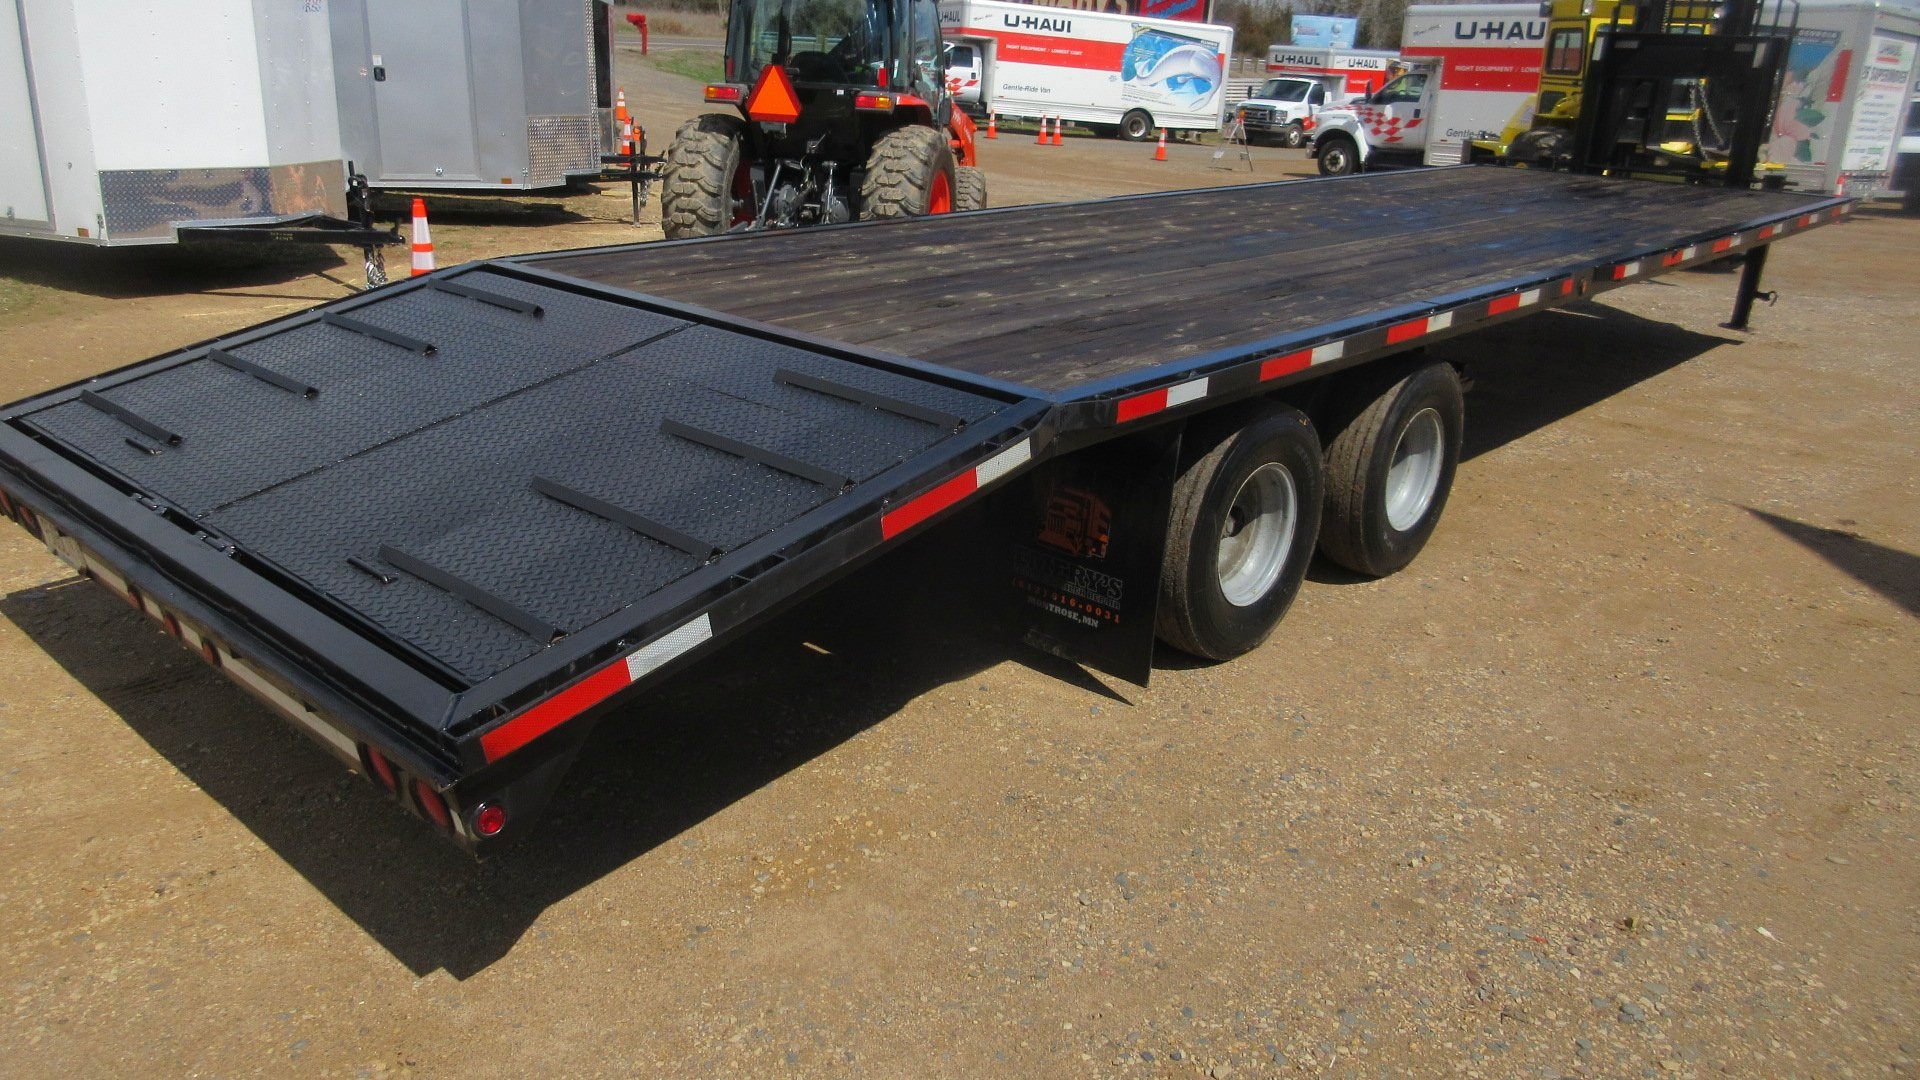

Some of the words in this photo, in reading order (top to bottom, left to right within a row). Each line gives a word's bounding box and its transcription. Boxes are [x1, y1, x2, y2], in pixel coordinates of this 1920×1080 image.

[1454, 21, 1546, 40] U-HAU
[1274, 54, 1321, 66] U-HAUL
[1348, 58, 1379, 69] U-HAUL
